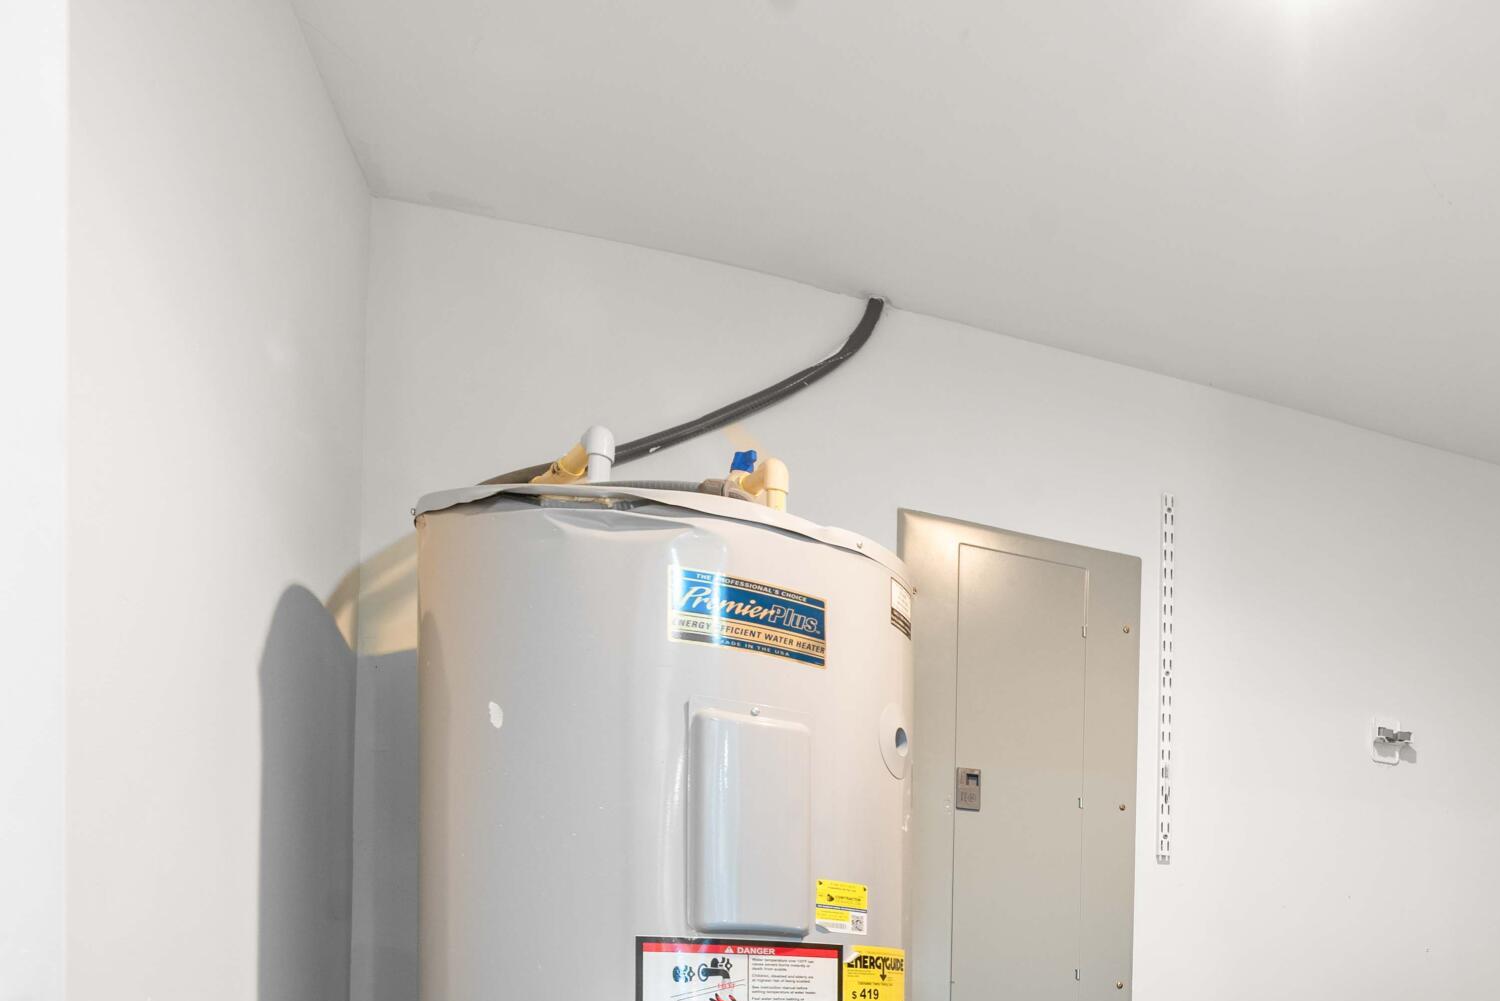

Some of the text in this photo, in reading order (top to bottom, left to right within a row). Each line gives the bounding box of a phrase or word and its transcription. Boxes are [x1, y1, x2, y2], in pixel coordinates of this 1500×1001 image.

[696, 573, 712, 581] THE
[781, 591, 808, 603] CHOICE
[764, 633, 794, 646] WATER
[796, 640, 825, 654] HEATER
[757, 645, 771, 653] THE
[774, 648, 790, 657] USA
[736, 946, 776, 955] DANGER
[860, 988, 879, 1000] 419
